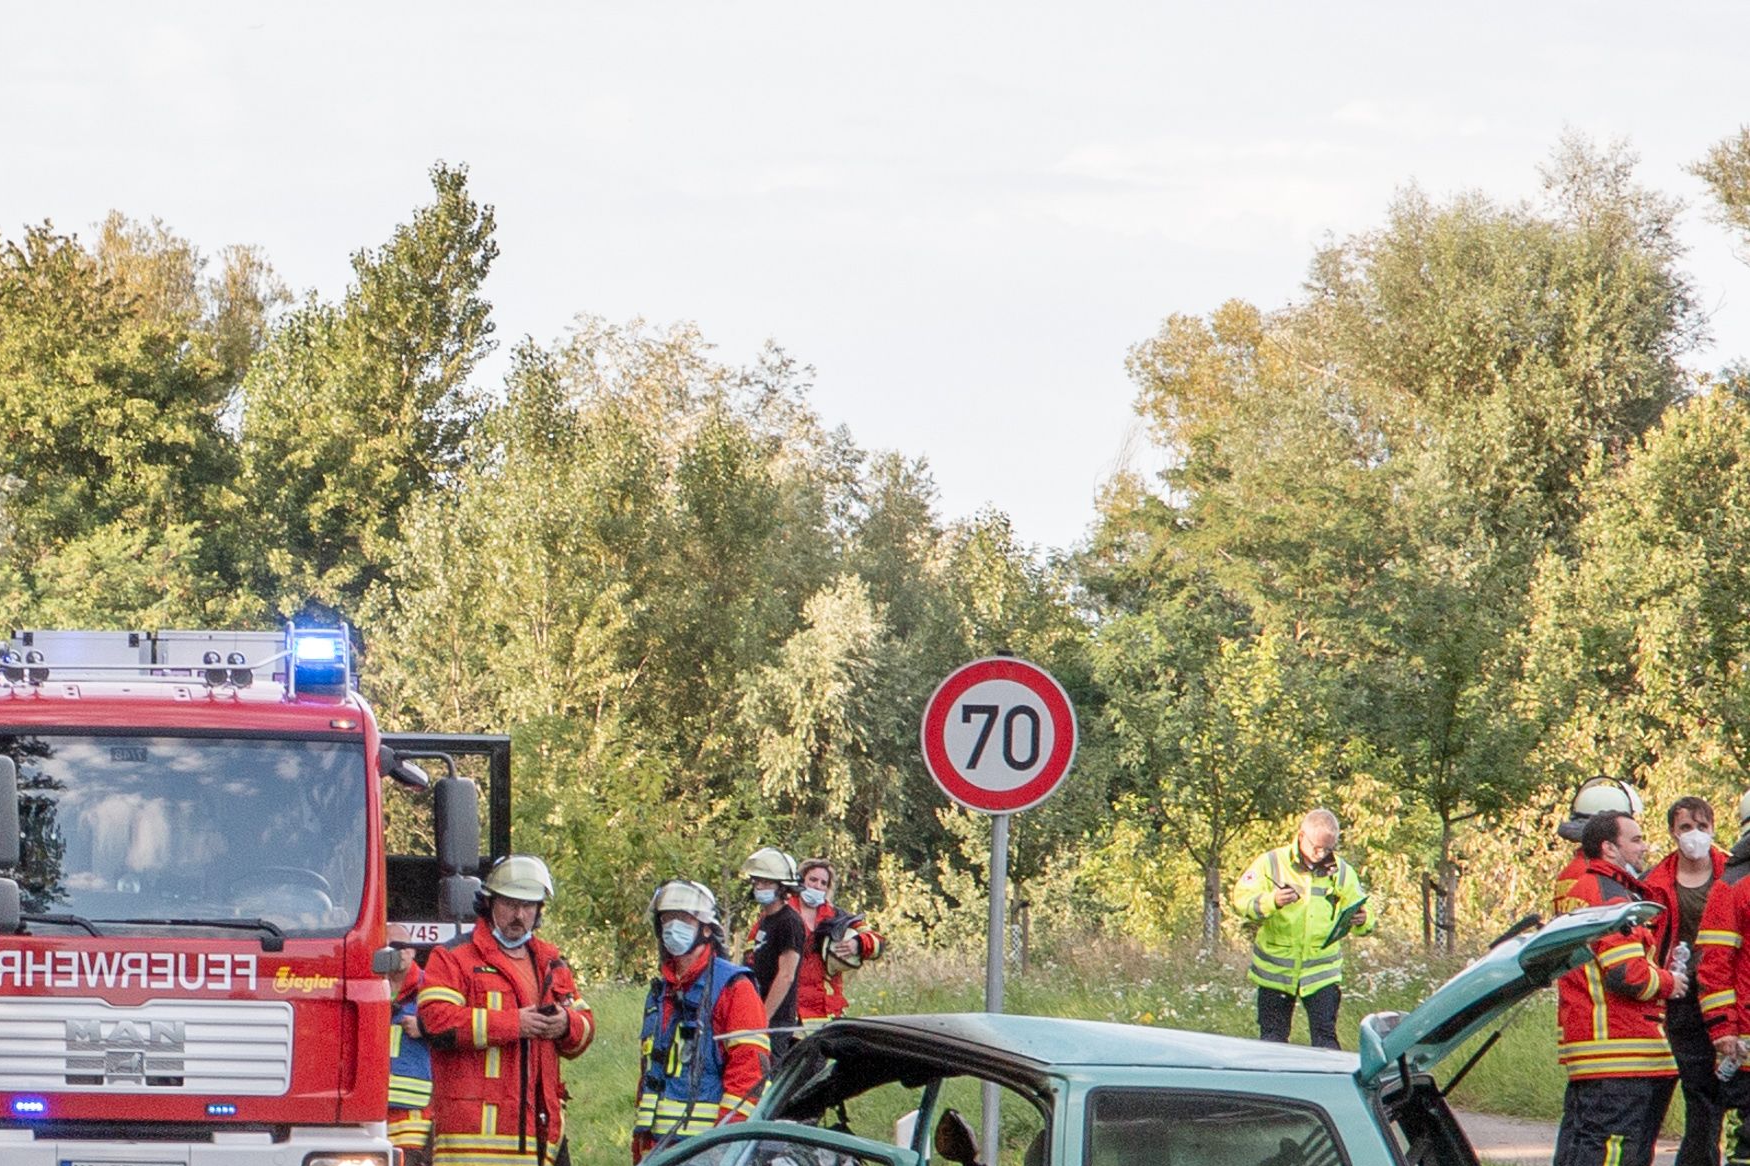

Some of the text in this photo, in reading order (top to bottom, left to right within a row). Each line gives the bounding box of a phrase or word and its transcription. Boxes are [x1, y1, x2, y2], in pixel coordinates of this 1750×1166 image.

[962, 704, 1041, 771] 70
[273, 966, 339, 993] Ziegler
[66, 1020, 185, 1044] MAN
